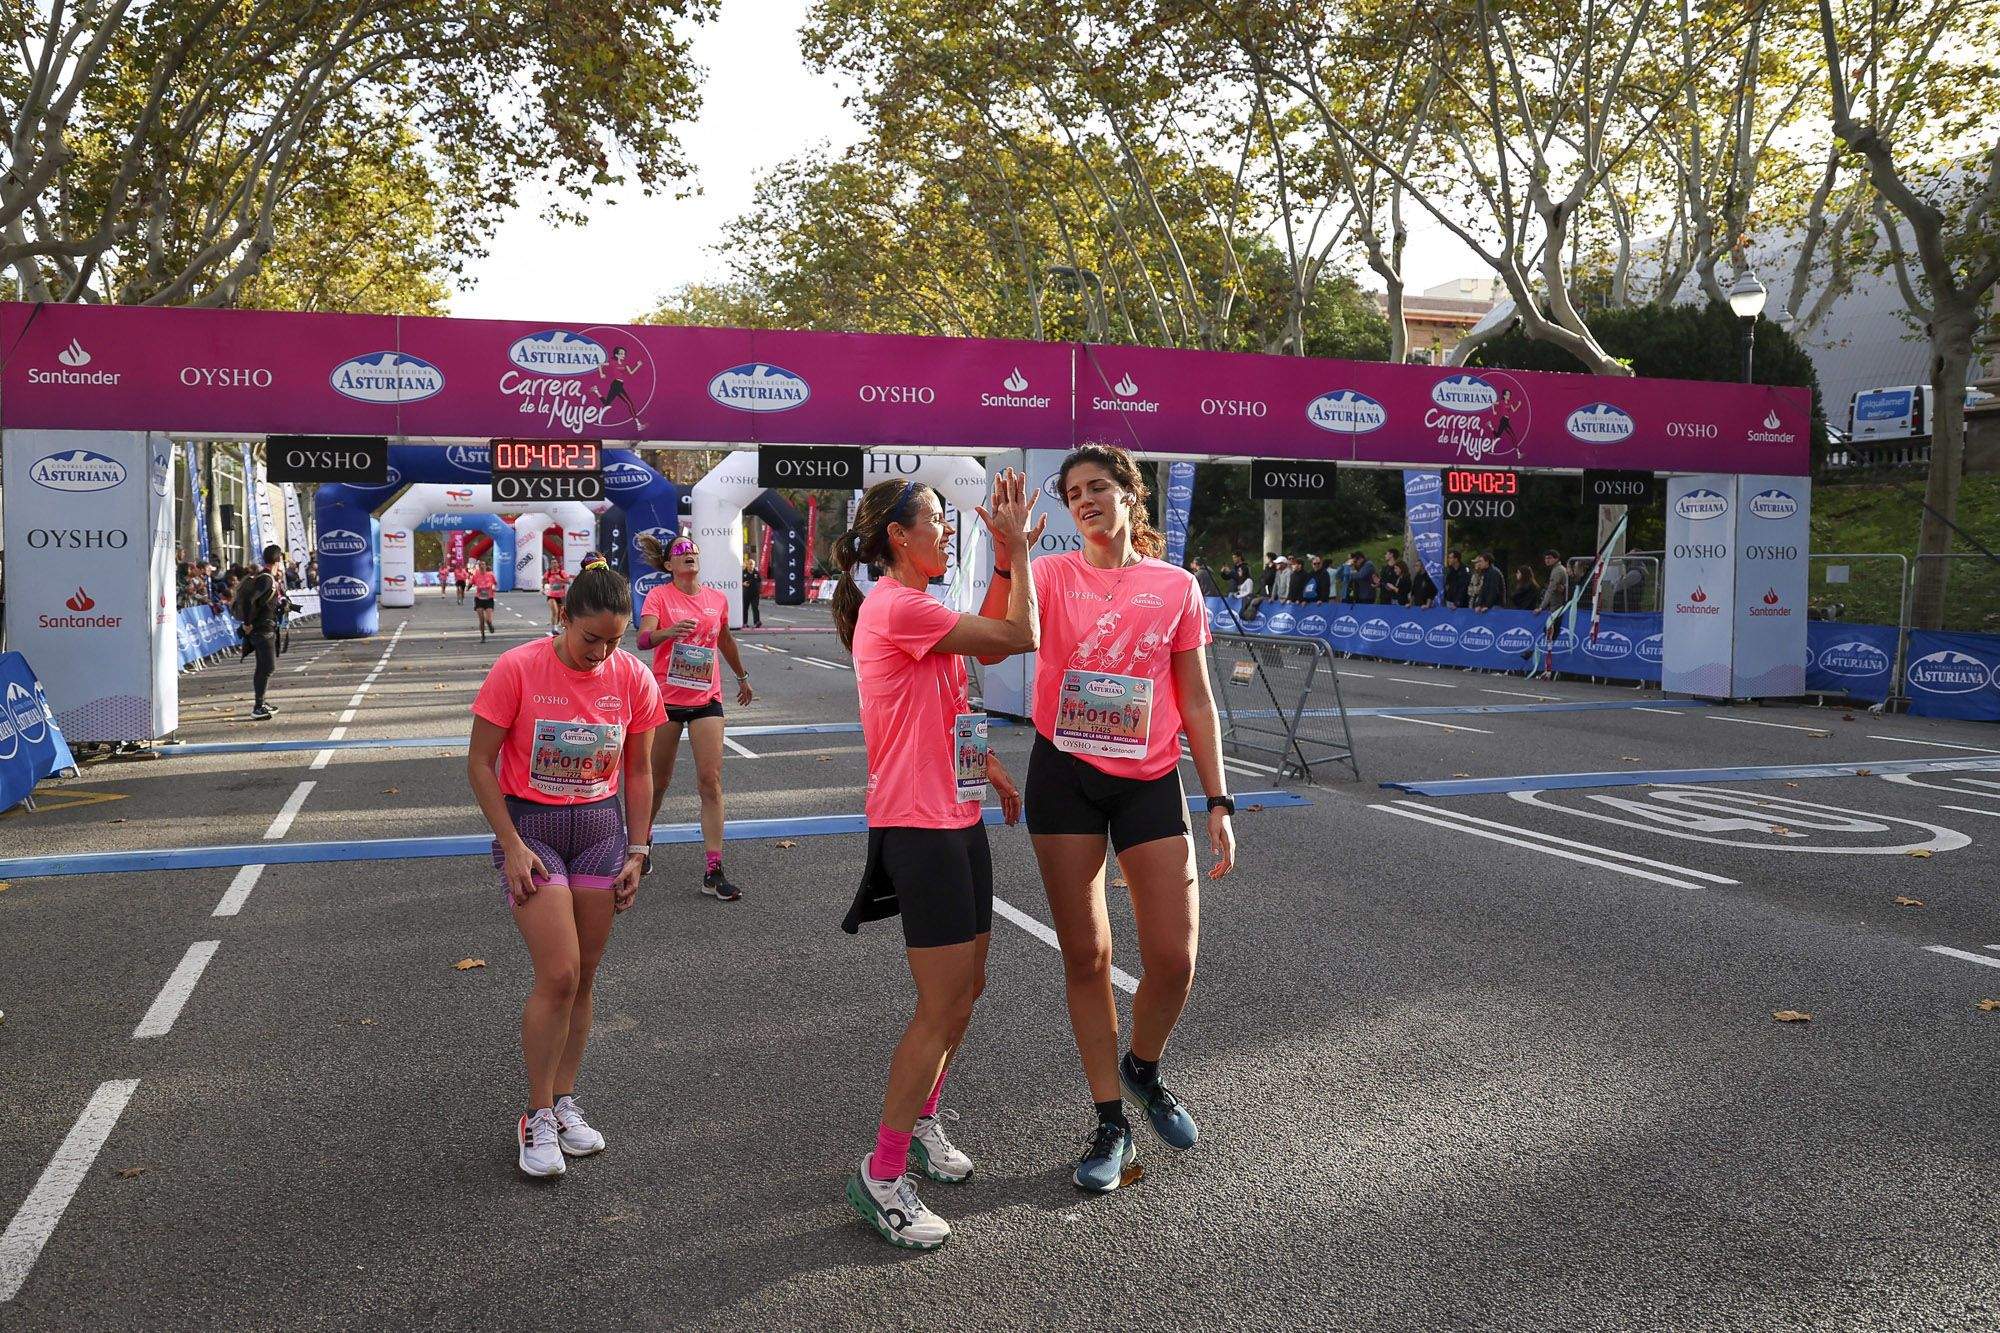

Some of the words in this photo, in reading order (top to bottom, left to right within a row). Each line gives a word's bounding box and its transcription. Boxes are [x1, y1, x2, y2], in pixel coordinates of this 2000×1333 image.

[516, 345, 600, 365] ASTURIANA
[28, 368, 121, 385] Santander
[180, 367, 273, 387] OYSHO
[339, 369, 436, 390] ASTURIANA
[499, 370, 583, 396] Carrera
[716, 379, 803, 400] ASTURIANA
[859, 384, 936, 404] OYSHO
[1436, 387, 1494, 404] ASTURIANA
[980, 393, 1051, 408] Santander
[1093, 396, 1160, 413] Santander
[1200, 398, 1267, 417] OYSHO
[519, 396, 536, 413] de
[538, 397, 550, 413] la
[546, 395, 612, 434] Mujer
[1312, 404, 1381, 424] ASTURIANA
[1424, 408, 1481, 430] Carrera
[1571, 417, 1630, 434] ASTURIANA
[1666, 422, 1718, 439] OYSHO
[1438, 430, 1449, 444] de
[1450, 430, 1459, 444] la
[1456, 429, 1501, 461] Mujer
[1747, 430, 1796, 443] Santander
[286, 451, 371, 470] OYSHO
[497, 444, 596, 469] 00:40:23
[37, 465, 120, 482] ASTURIANA
[775, 459, 850, 478] OYSHO
[603, 472, 648, 484] STURIANA
[1264, 472, 1326, 490] OYSHO
[496, 477, 600, 499] OYSHO
[1594, 480, 1645, 495] OYSHO
[1447, 499, 1516, 518] OYSHO
[1679, 502, 1724, 514] ASTURIANA
[1752, 502, 1794, 513] ASTURIANA
[27, 529, 128, 549] OYSHO
[1040, 534, 1082, 551] OYS
[1673, 544, 1727, 559] OYSHO
[1746, 545, 1798, 560] OYSHO
[788, 530, 796, 596] VOLVO
[1066, 591, 1103, 602] OYSHO
[1676, 603, 1720, 615] Santander
[1749, 606, 1792, 616] Santander
[39, 615, 122, 628] Santander
[1822, 653, 1883, 670] ASTURIANA
[1914, 666, 1984, 684] ASTURIANA
[533, 694, 569, 705] OYSHO
[1086, 708, 1121, 725] 016
[1063, 739, 1092, 750] OYSHO
[560, 755, 593, 769] 016
[537, 781, 565, 792] OYSHO
